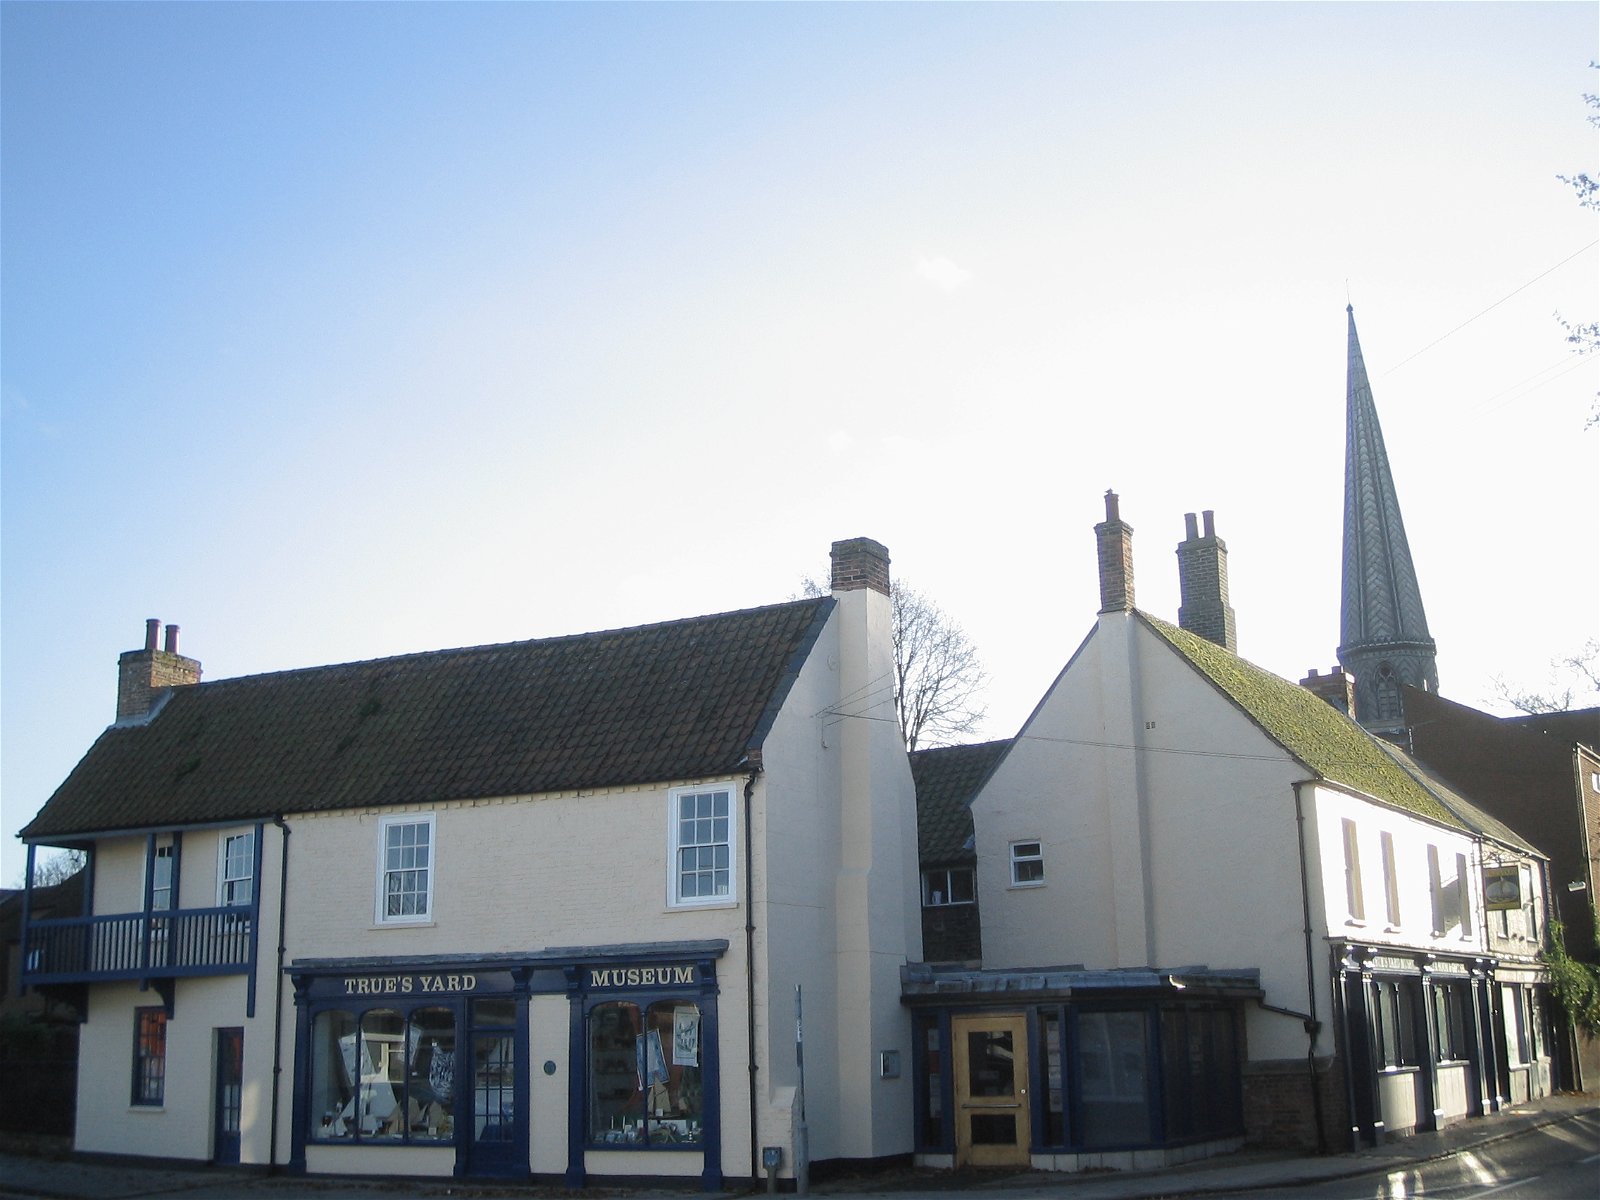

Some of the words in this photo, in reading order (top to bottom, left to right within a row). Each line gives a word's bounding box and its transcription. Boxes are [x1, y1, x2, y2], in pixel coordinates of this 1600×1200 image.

[344, 976, 413, 994] TRUE'S
[419, 975, 477, 992] YARD
[590, 966, 694, 987] MUSEUM
